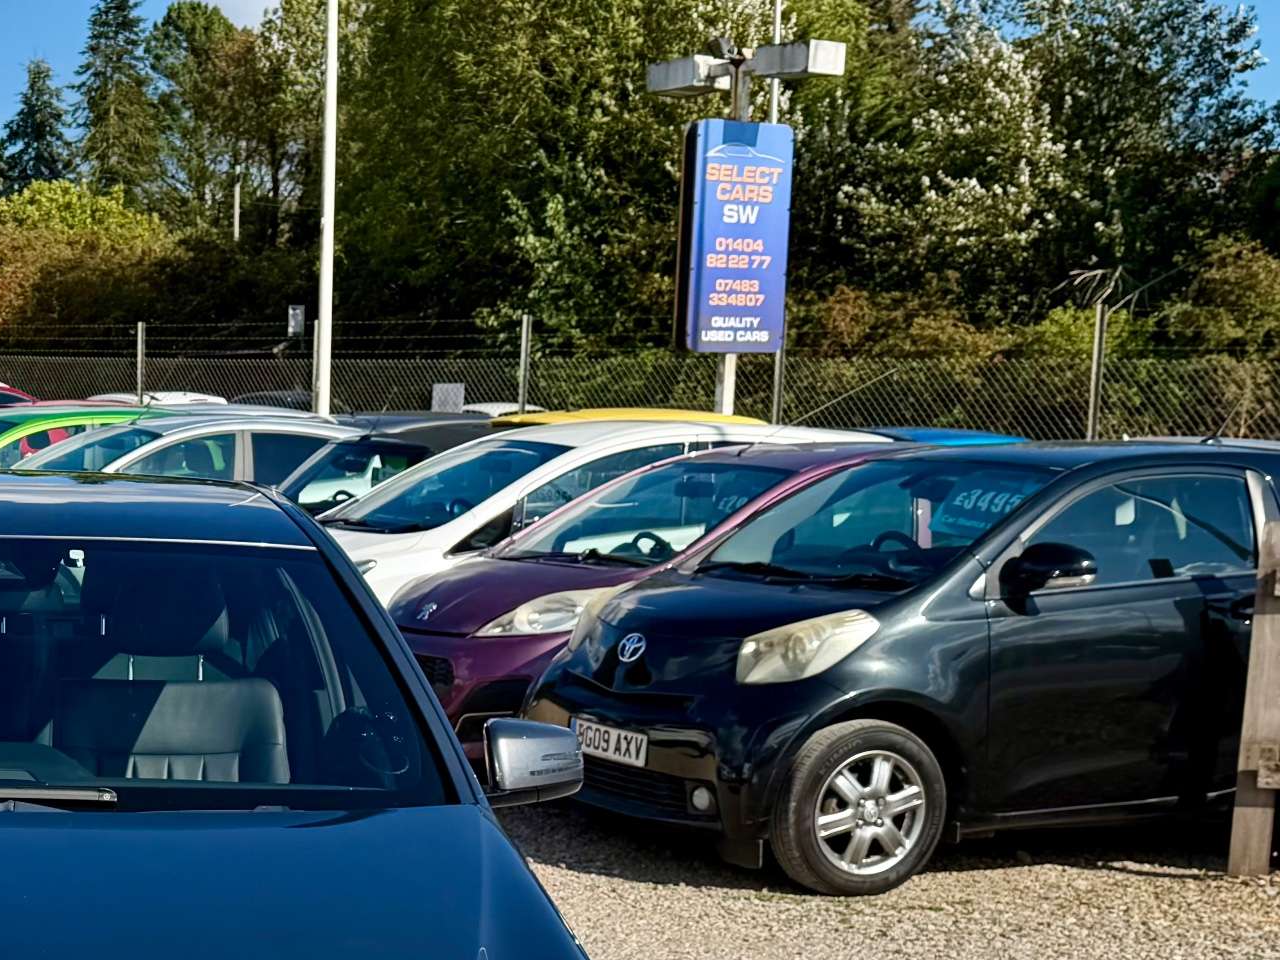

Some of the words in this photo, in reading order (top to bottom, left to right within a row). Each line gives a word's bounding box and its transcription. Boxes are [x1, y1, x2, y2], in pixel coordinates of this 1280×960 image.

[705, 163, 783, 184] SELECT
[716, 183, 773, 203] CARS
[723, 204, 759, 224] SW
[715, 237, 764, 253] 01404
[709, 293, 765, 307] 334807
[711, 316, 761, 328] QUALITY
[701, 330, 734, 341] USED
[736, 331, 769, 342] CARS
[613, 732, 643, 761] AXV
